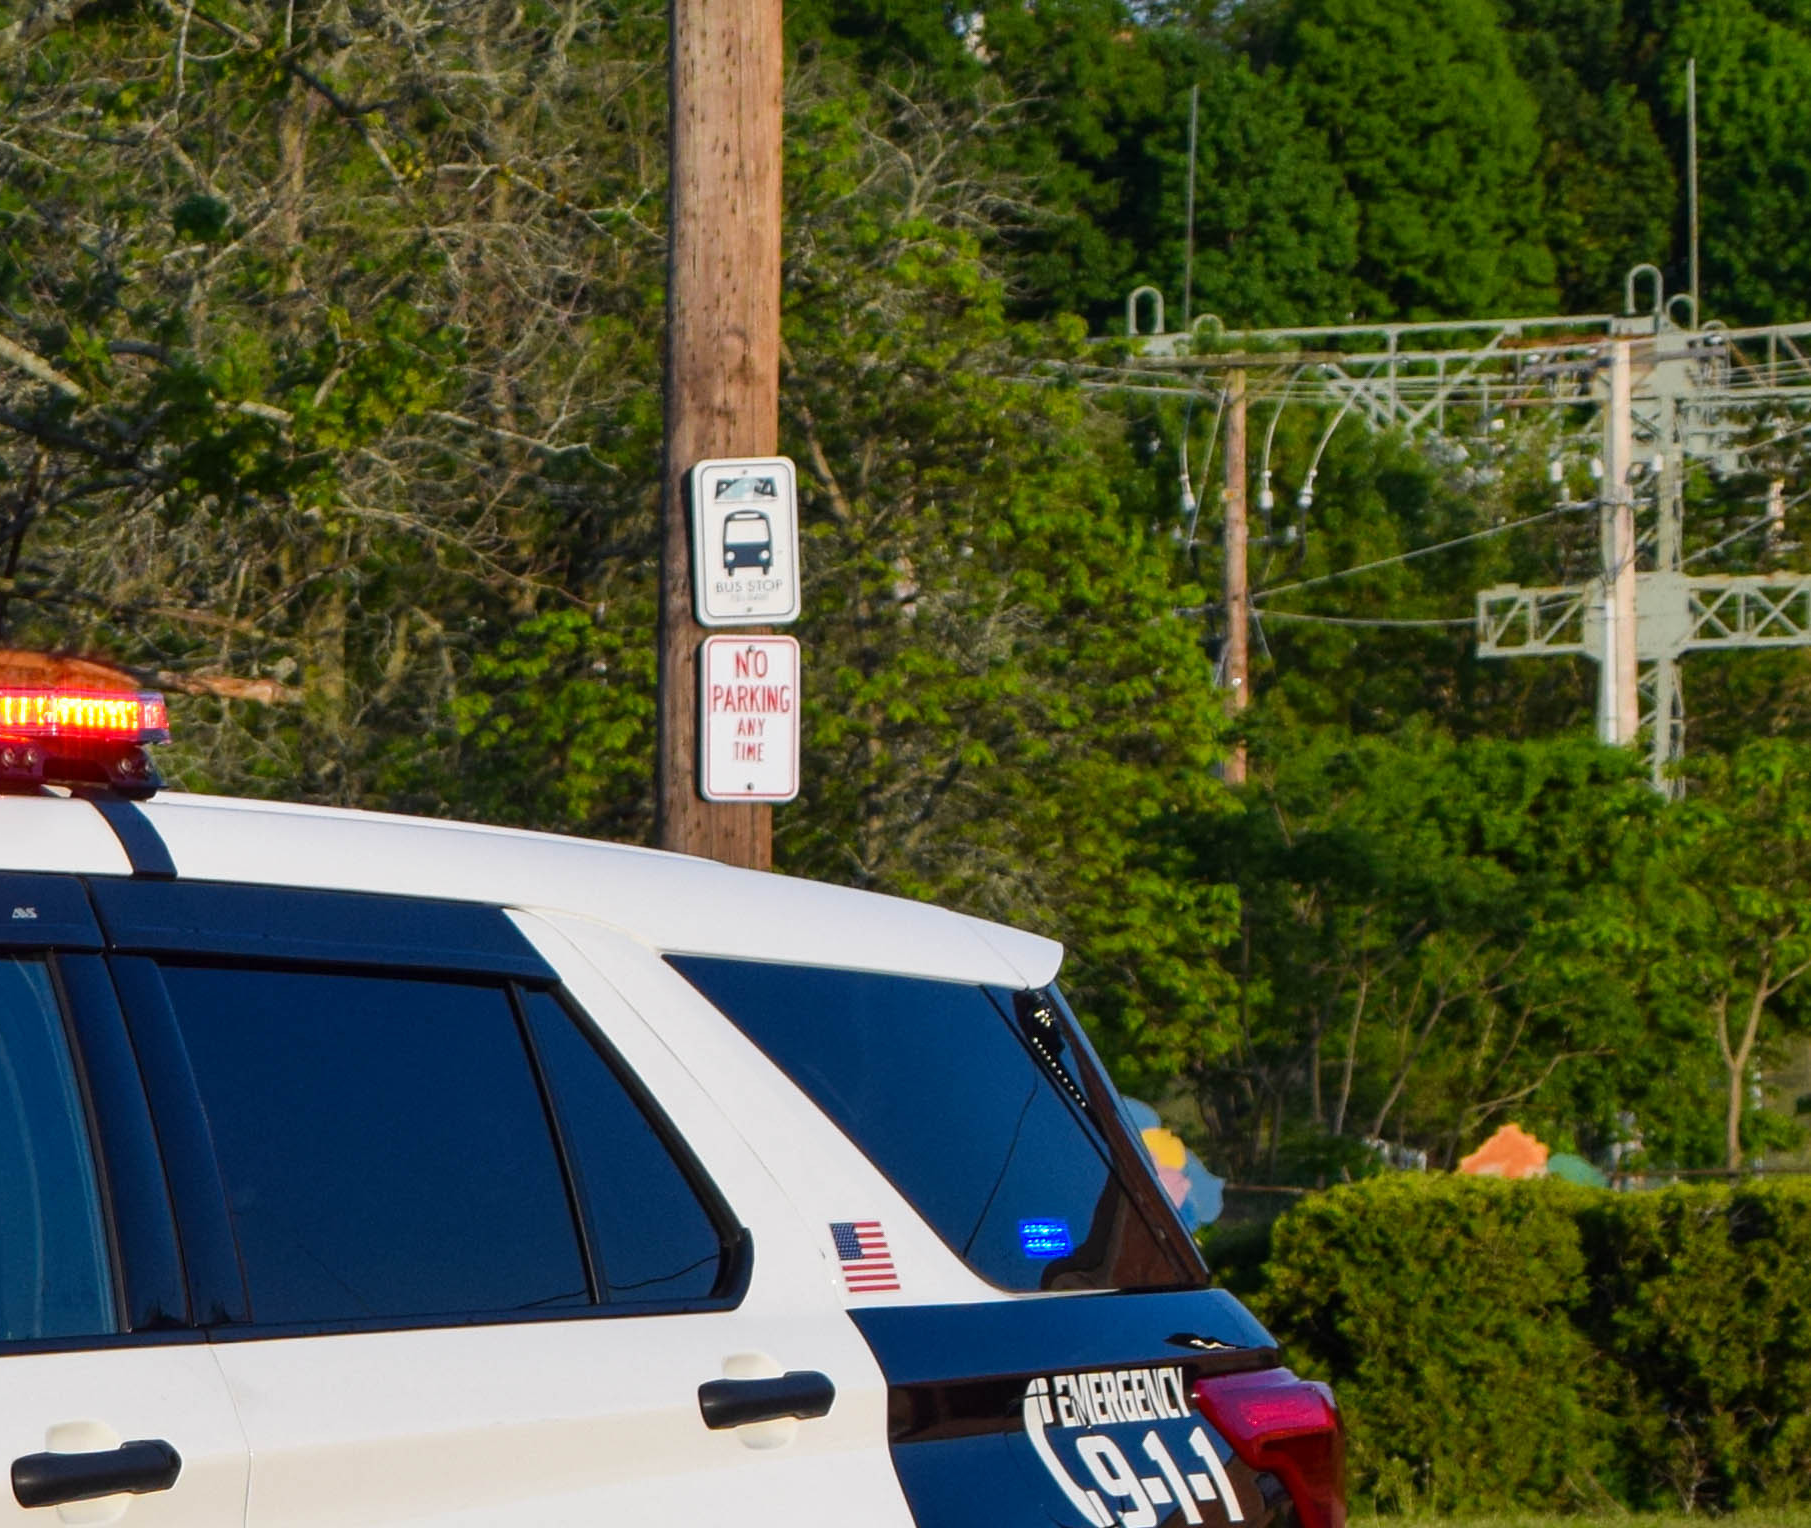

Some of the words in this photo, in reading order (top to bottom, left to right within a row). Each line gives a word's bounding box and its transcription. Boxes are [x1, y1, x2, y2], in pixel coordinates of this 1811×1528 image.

[715, 581, 743, 593] BUS
[748, 578, 783, 592] STOP
[734, 650, 768, 679] NO
[712, 685, 791, 714] PARKING
[737, 718, 766, 737] ANY
[733, 742, 765, 762] TIME
[1054, 1367, 1191, 1428] EMERGENCY
